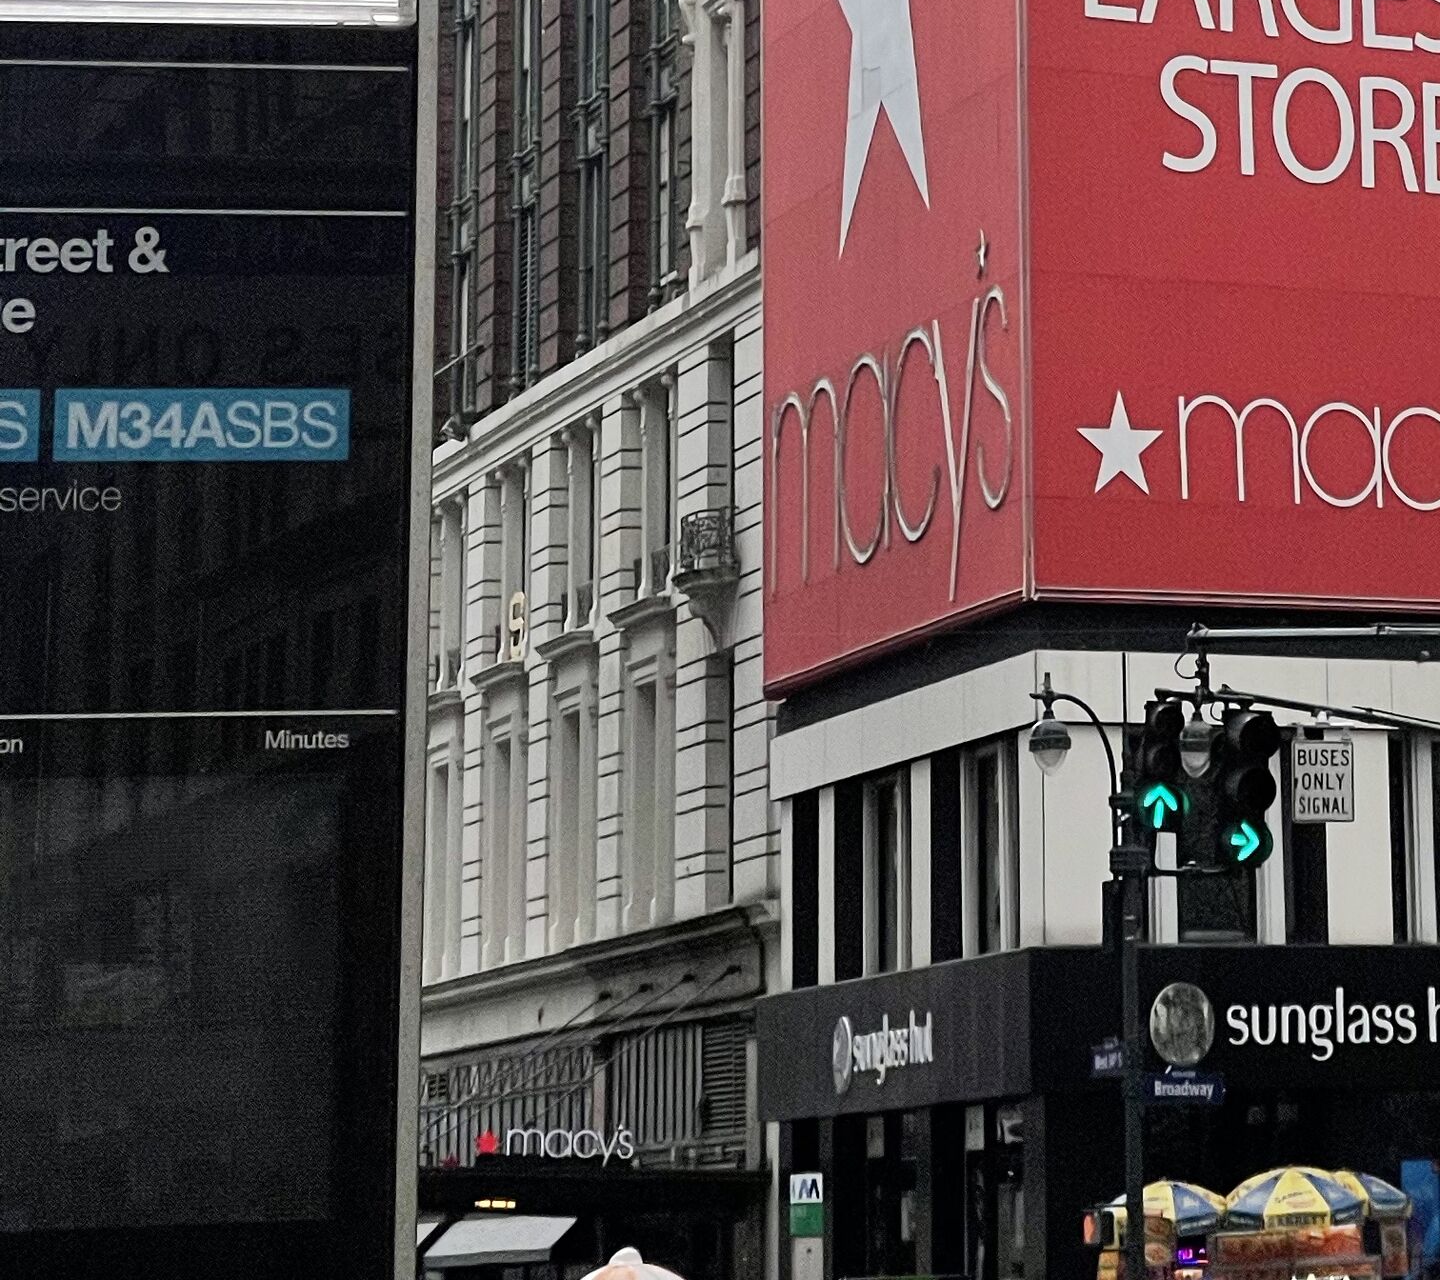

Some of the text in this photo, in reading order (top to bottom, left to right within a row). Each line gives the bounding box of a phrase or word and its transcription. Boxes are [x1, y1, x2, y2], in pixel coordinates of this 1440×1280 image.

[0, 226, 170, 274] reet &
[66, 400, 338, 450] M34ASBS
[771, 230, 1014, 602] macy's
[0, 479, 122, 512] service
[264, 729, 349, 750] Minutes
[1297, 749, 1350, 767] BUSES
[1301, 772, 1345, 791] ONLY
[1298, 796, 1349, 815] SIGNAL
[1226, 987, 1417, 1061] sunglass
[1153, 1080, 1215, 1100] Broadway
[505, 1124, 635, 1168] macy's
